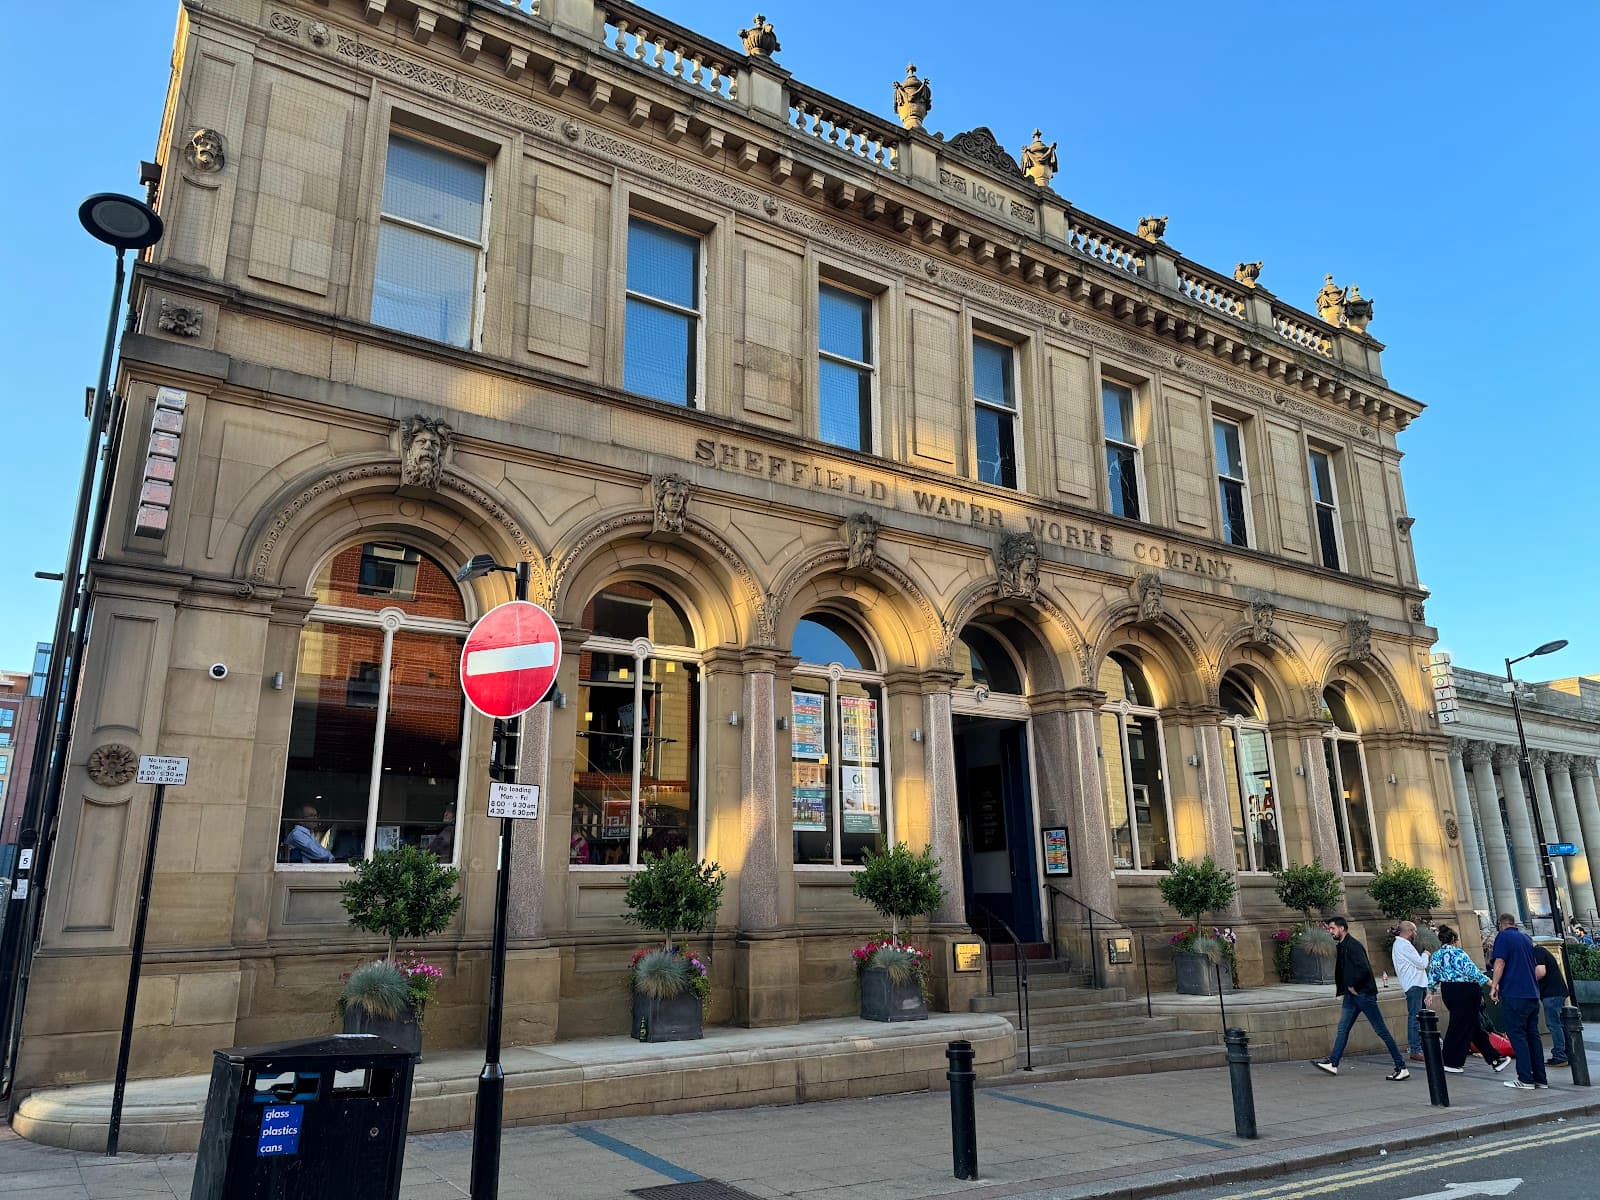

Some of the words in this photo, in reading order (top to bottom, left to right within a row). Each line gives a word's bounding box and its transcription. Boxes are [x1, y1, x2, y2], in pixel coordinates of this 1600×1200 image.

[972, 182, 1005, 212] 1867
[695, 438, 887, 500] SHEFFIELD
[913, 490, 1004, 528] WATER
[1026, 516, 1113, 552] WORKS
[1434, 655, 1450, 722] LLOYDS
[510, 785, 532, 794] loading
[265, 1109, 290, 1121] glass
[262, 1124, 298, 1139] plastics
[260, 1144, 283, 1153] cans
